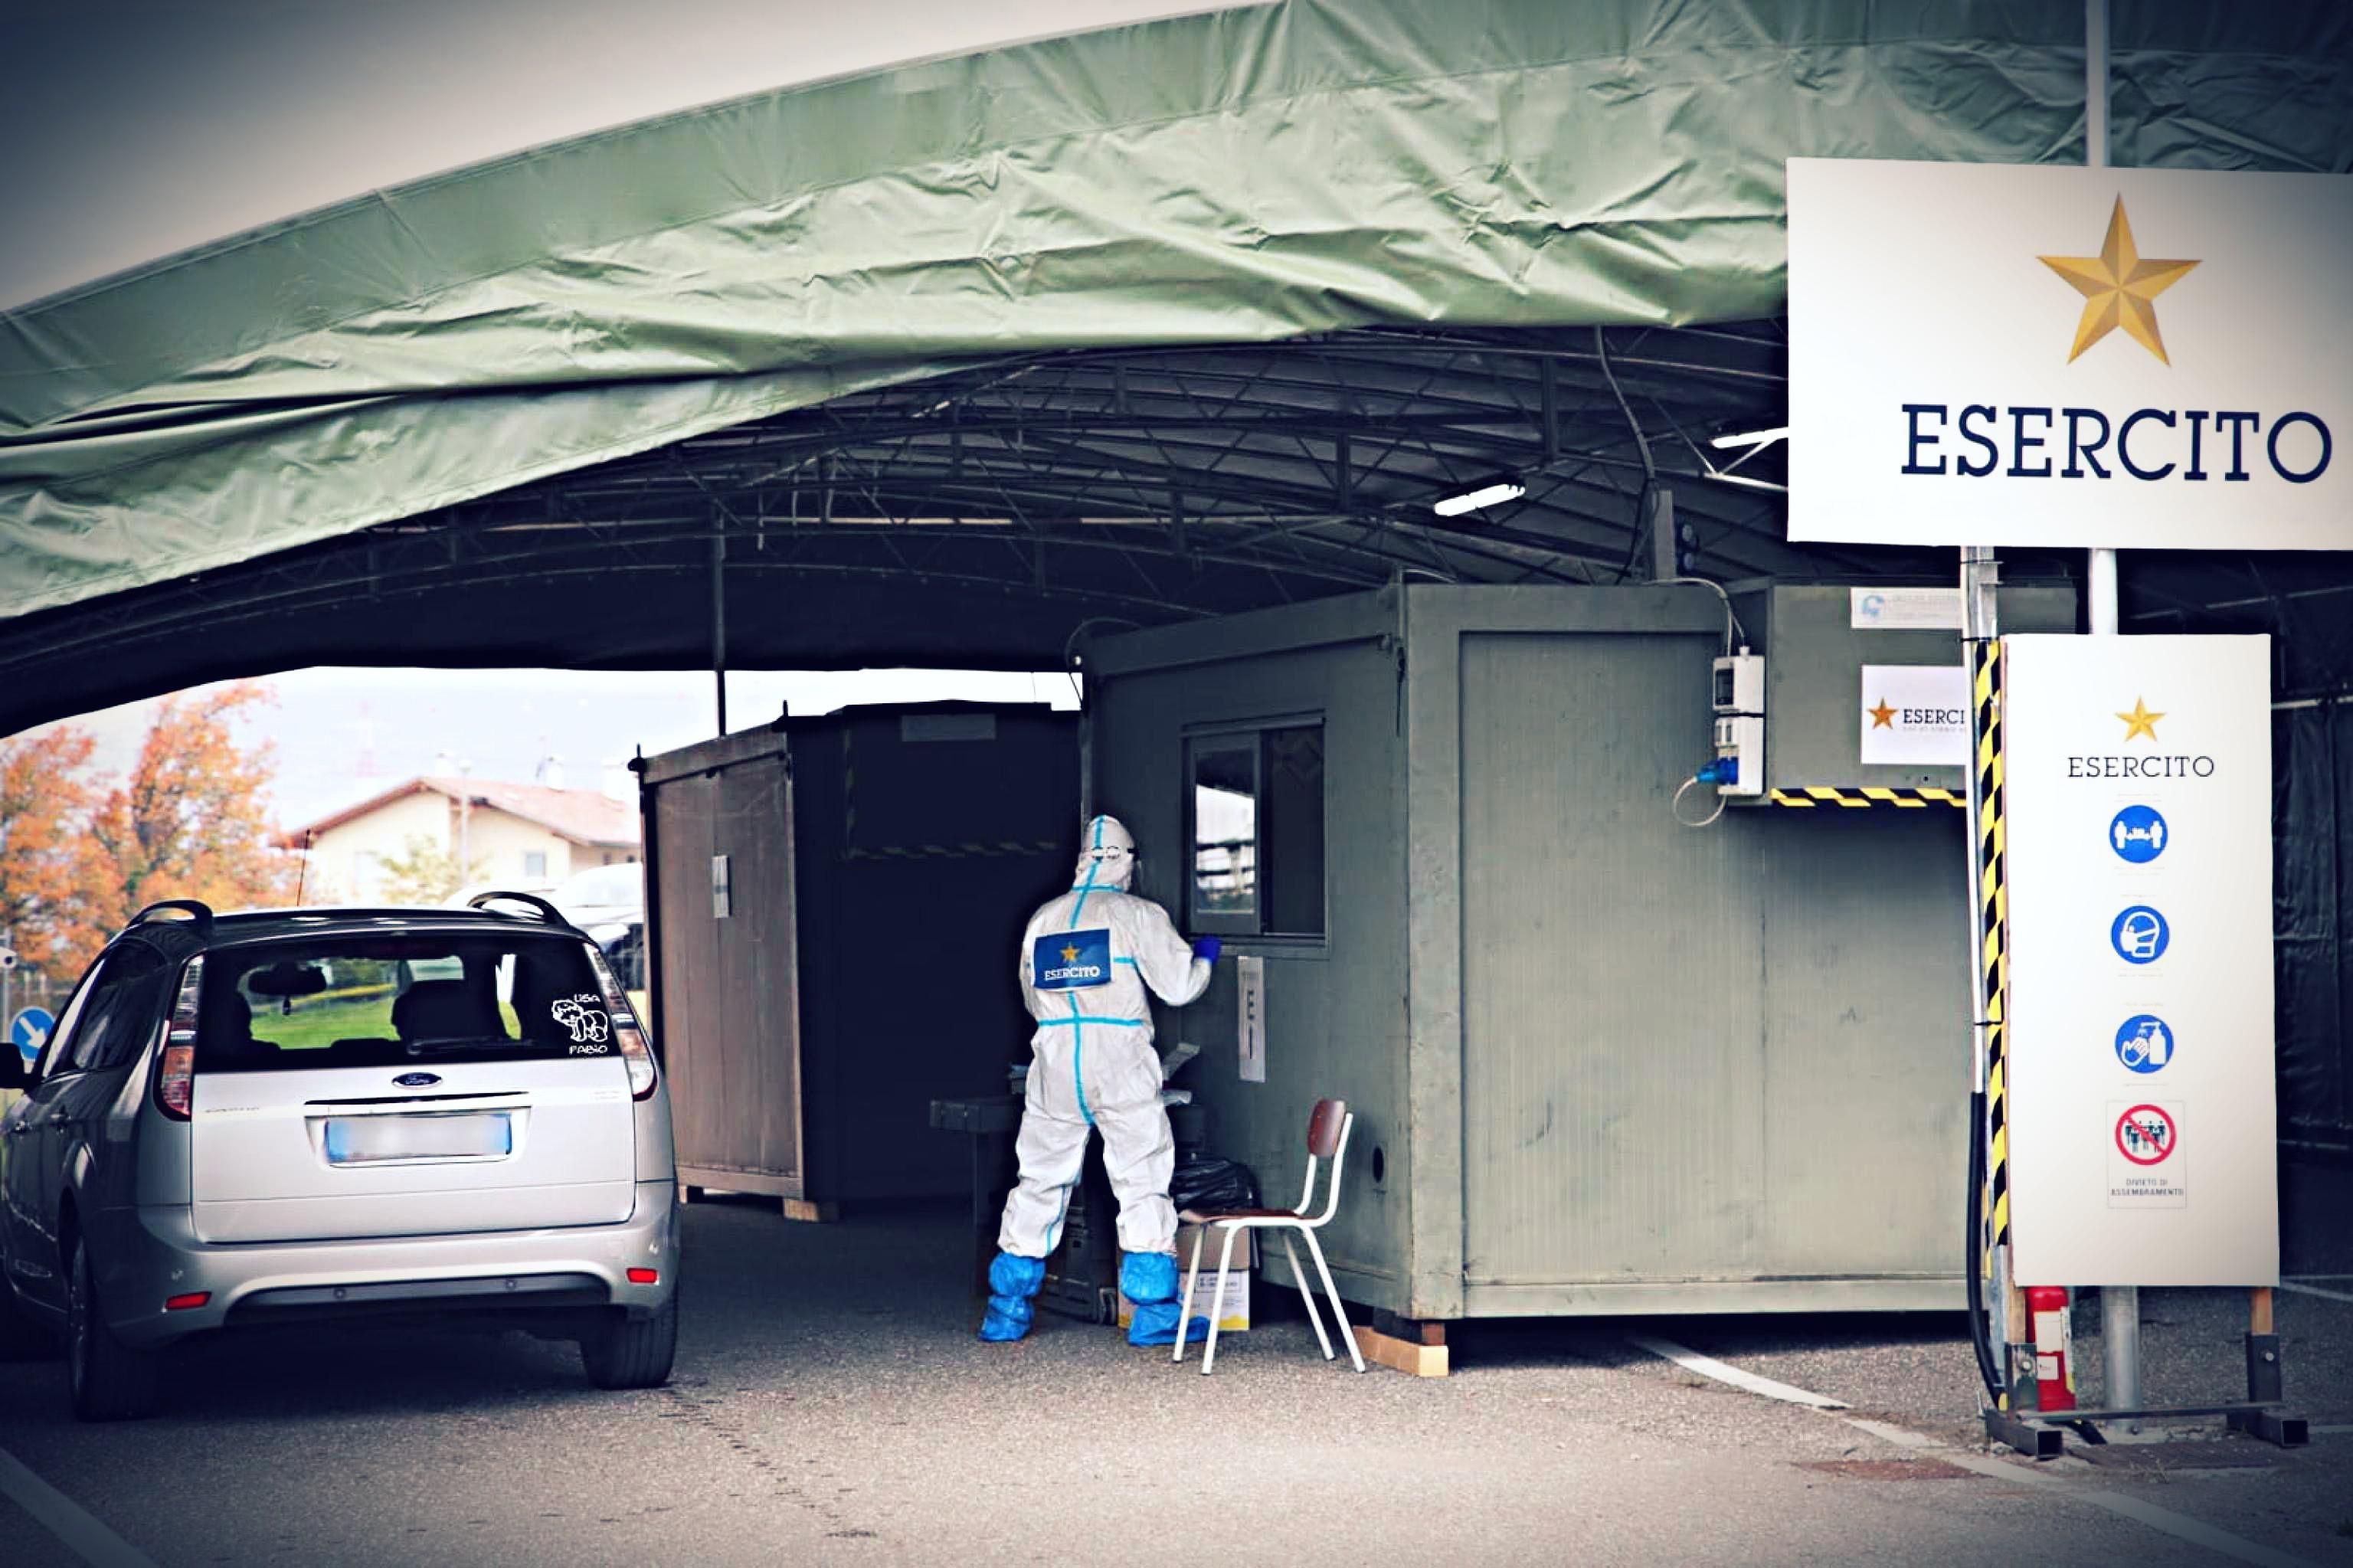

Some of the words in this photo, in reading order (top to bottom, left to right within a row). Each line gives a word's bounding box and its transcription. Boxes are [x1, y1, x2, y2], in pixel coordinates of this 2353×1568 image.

[1900, 403, 2333, 484] ESERCITO
[2067, 755, 2214, 777] ESERCITO
[1045, 966, 1101, 980] ESERCITO
